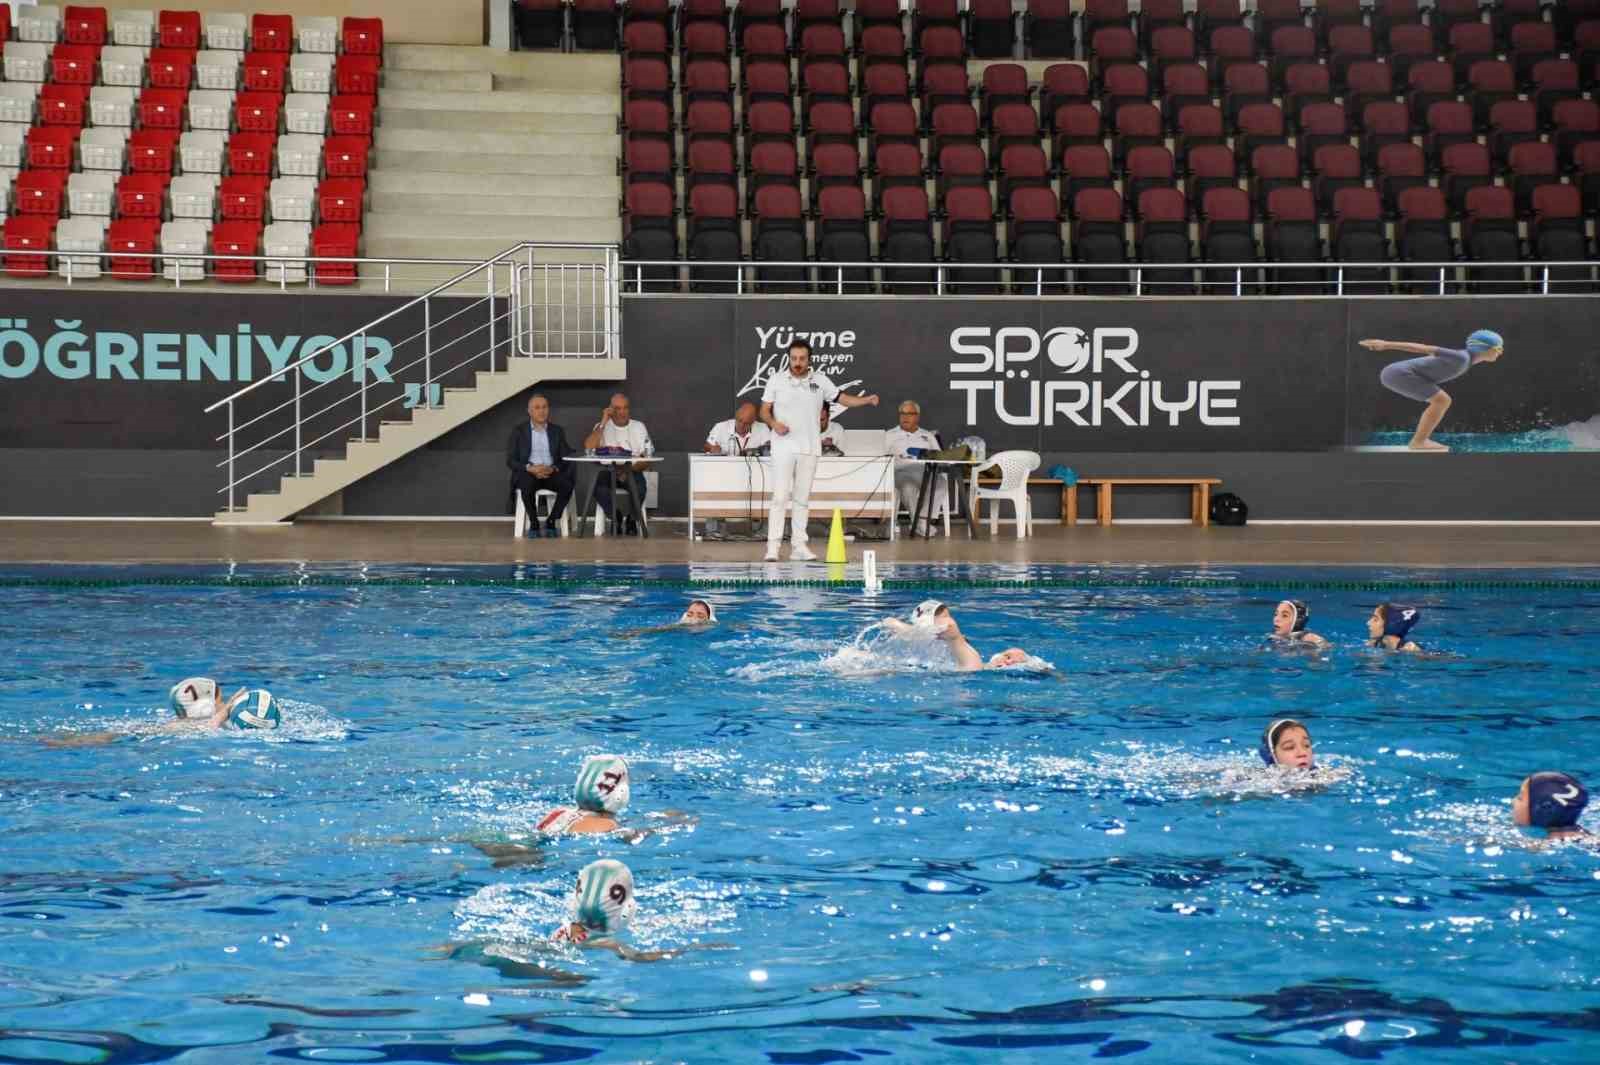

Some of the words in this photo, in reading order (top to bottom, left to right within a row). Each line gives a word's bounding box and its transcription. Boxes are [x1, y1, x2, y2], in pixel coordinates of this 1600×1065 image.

[0, 319, 394, 383] ÖĞRENİYOR
[950, 327, 1139, 373] SPOR
[950, 369, 1241, 426] TÜRKİYE
[1401, 609, 1416, 620] 4
[597, 771, 623, 796] 11
[1552, 783, 1579, 807] 2
[609, 884, 626, 905] 9
